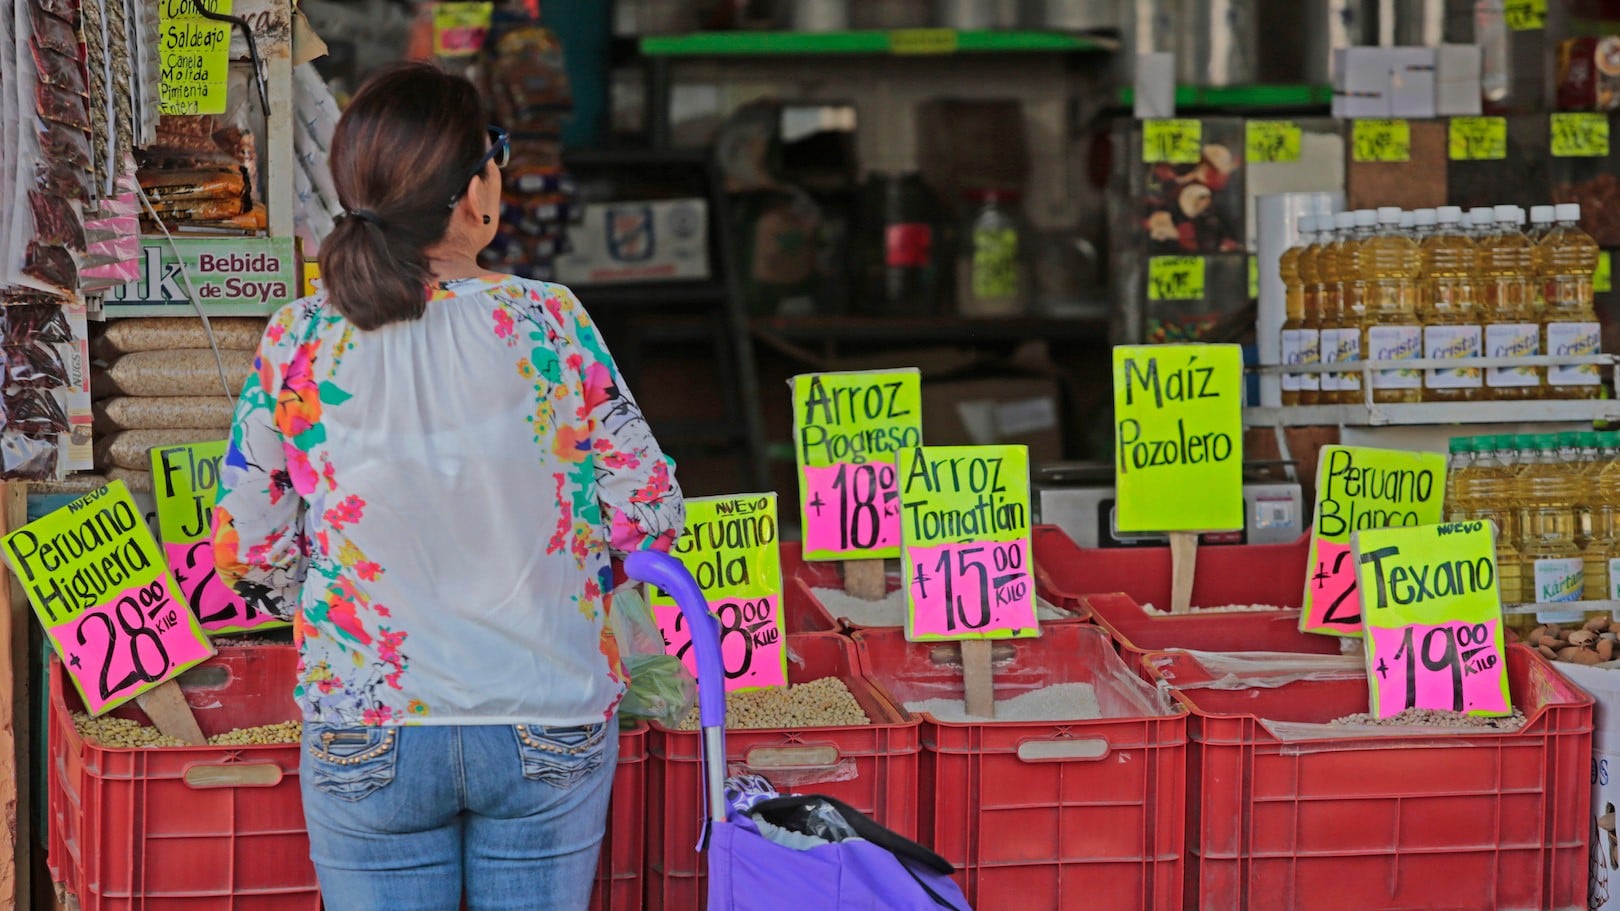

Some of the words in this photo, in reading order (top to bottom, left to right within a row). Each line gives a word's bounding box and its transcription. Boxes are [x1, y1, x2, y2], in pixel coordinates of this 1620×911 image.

[161, 68, 208, 81] Molida
[167, 53, 203, 68] Canela
[161, 83, 208, 100] Pimienta
[200, 253, 279, 273] Bebida
[199, 283, 221, 298] de
[225, 278, 287, 303] Soya
[805, 376, 910, 425] Arroz
[1124, 354, 1220, 409] Maíz
[801, 425, 920, 466] Progreso
[1118, 419, 1232, 474] Pozolero
[160, 447, 223, 497] Flor
[904, 447, 1007, 494] Arroz
[1327, 450, 1433, 502] Peruano
[68, 486, 108, 515] NUEVO
[716, 498, 767, 515] NUEVO
[904, 495, 1025, 540] Tomatlán
[7, 500, 136, 582] Peruano
[674, 515, 774, 553] eruano
[1437, 522, 1483, 536] NUEVO
[33, 537, 151, 621] Higuera
[668, 552, 750, 594] ola
[1360, 546, 1494, 608] Texano
[995, 582, 1026, 607] KILO
[155, 609, 177, 635] KILO
[753, 628, 778, 649] KILO
[1464, 655, 1497, 676] KILO
